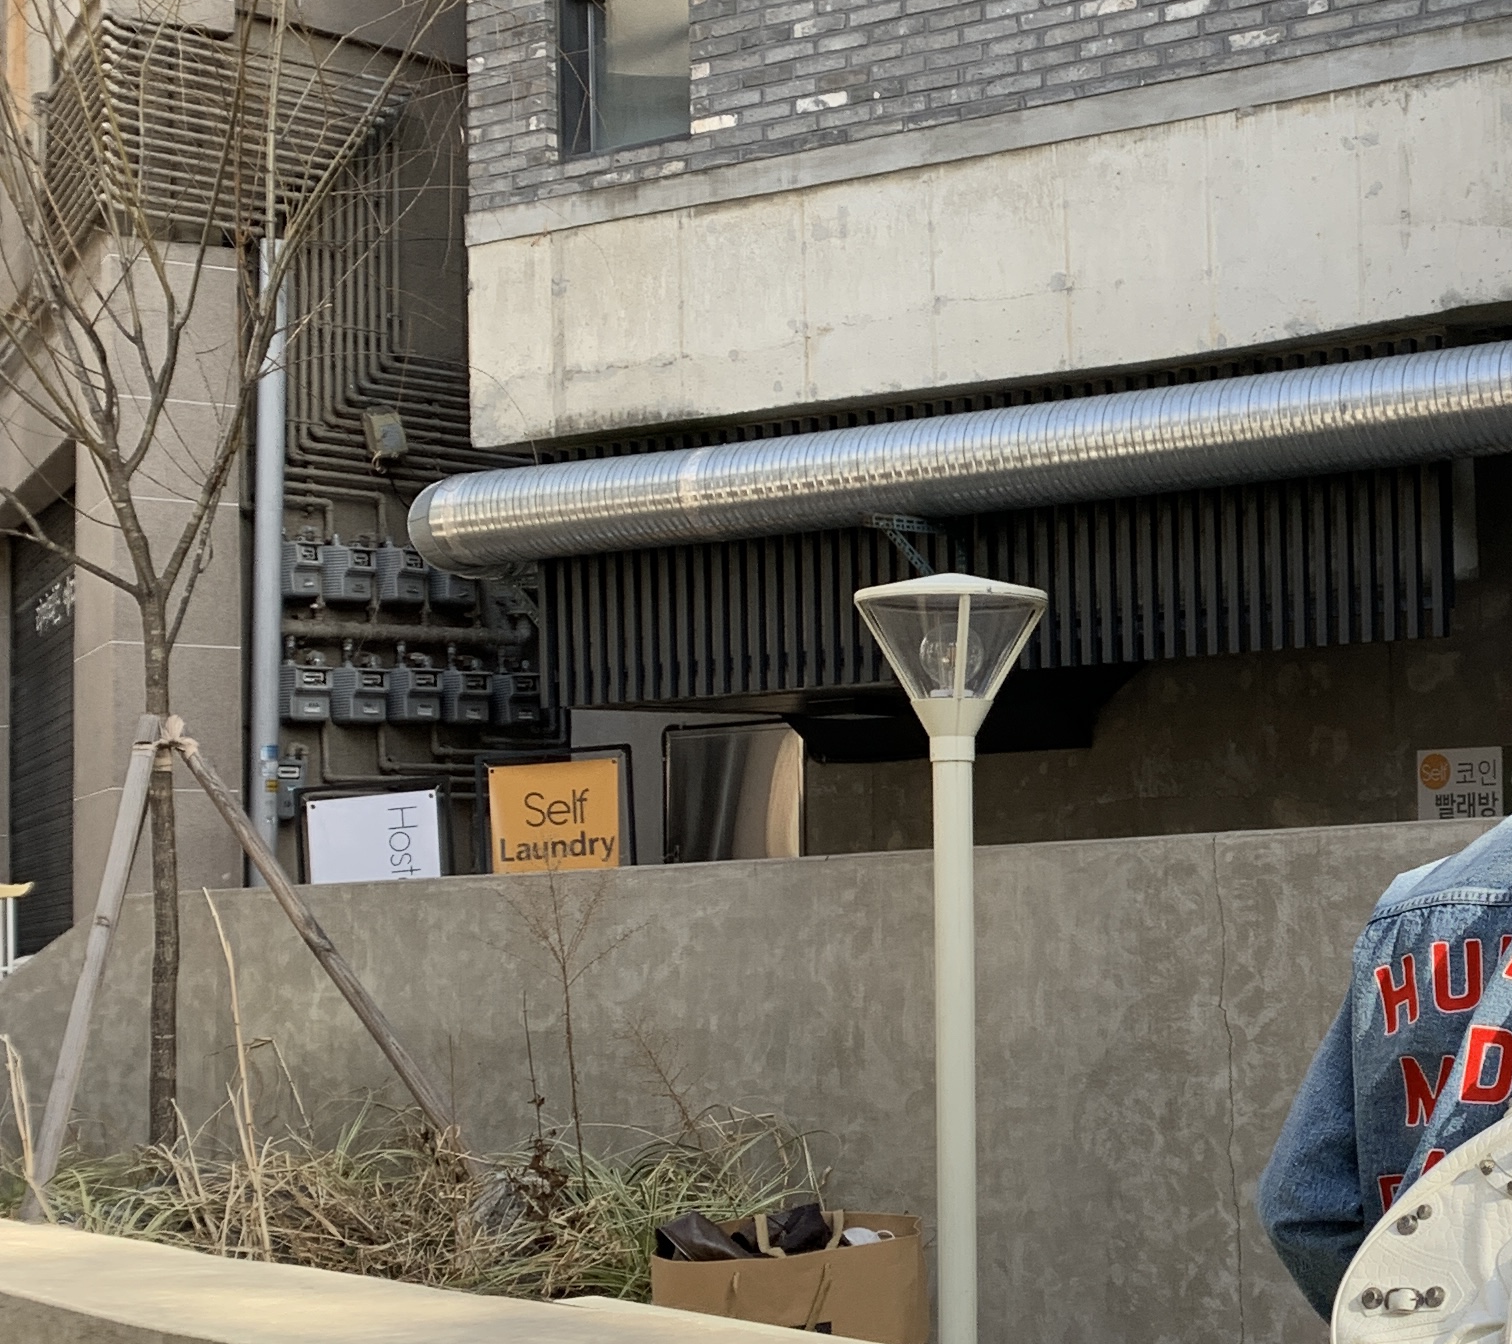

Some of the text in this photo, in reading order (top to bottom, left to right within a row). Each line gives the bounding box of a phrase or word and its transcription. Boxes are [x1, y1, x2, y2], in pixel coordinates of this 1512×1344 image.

[1422, 761, 1448, 782] Self
[1456, 759, 1497, 786] 코인
[524, 788, 589, 827] Self
[1435, 791, 1499, 818] 빨래방
[388, 806, 421, 879] Host
[500, 830, 615, 862] Laundry
